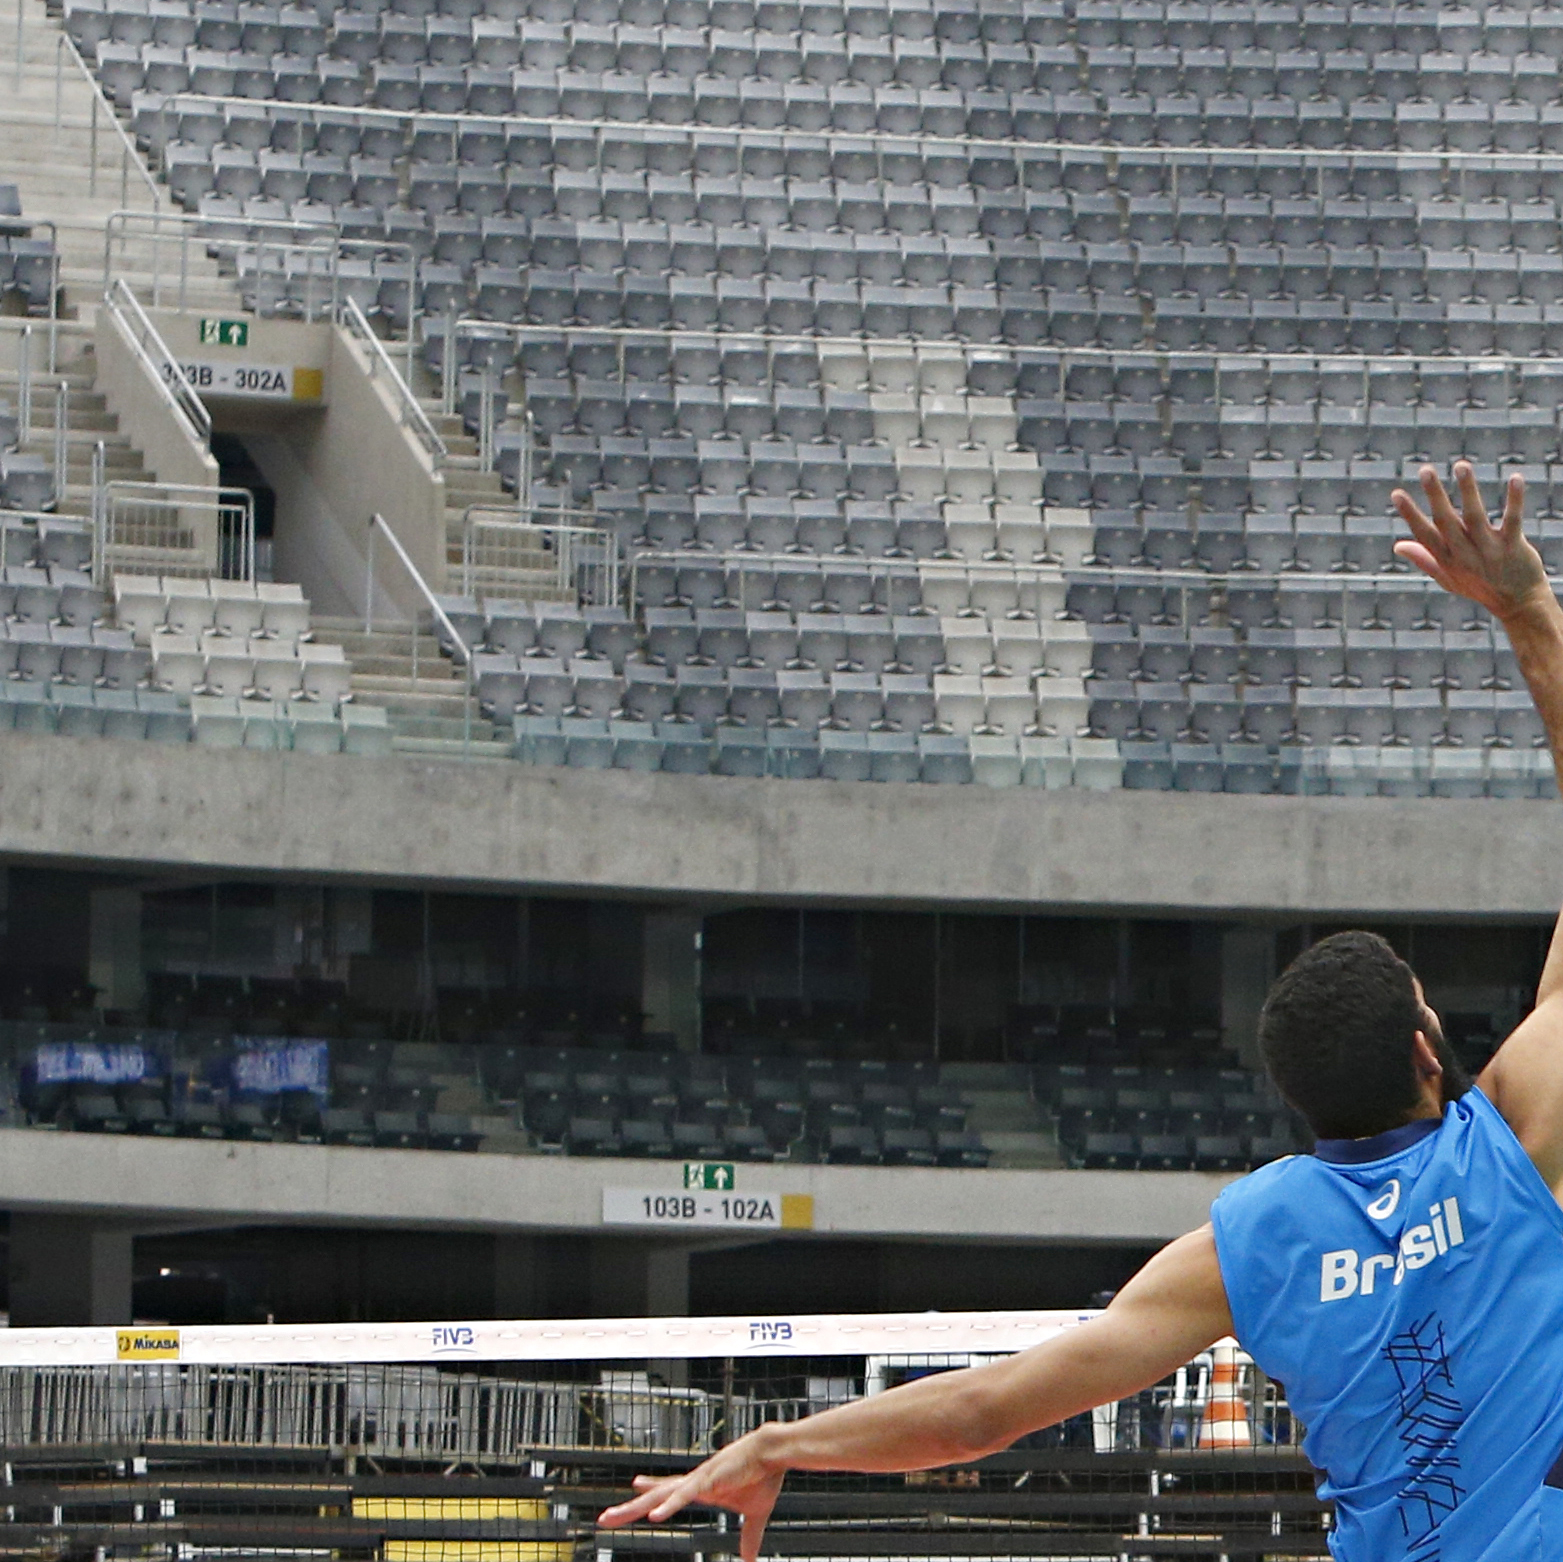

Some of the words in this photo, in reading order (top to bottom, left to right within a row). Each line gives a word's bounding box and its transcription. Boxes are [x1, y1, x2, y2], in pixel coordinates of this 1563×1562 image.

[234, 369, 288, 392] 302A
[643, 1196, 697, 1218] 103B
[721, 1197, 774, 1220] 102A
[432, 1327, 475, 1346] FIVB
[749, 1322, 793, 1341] FIVB
